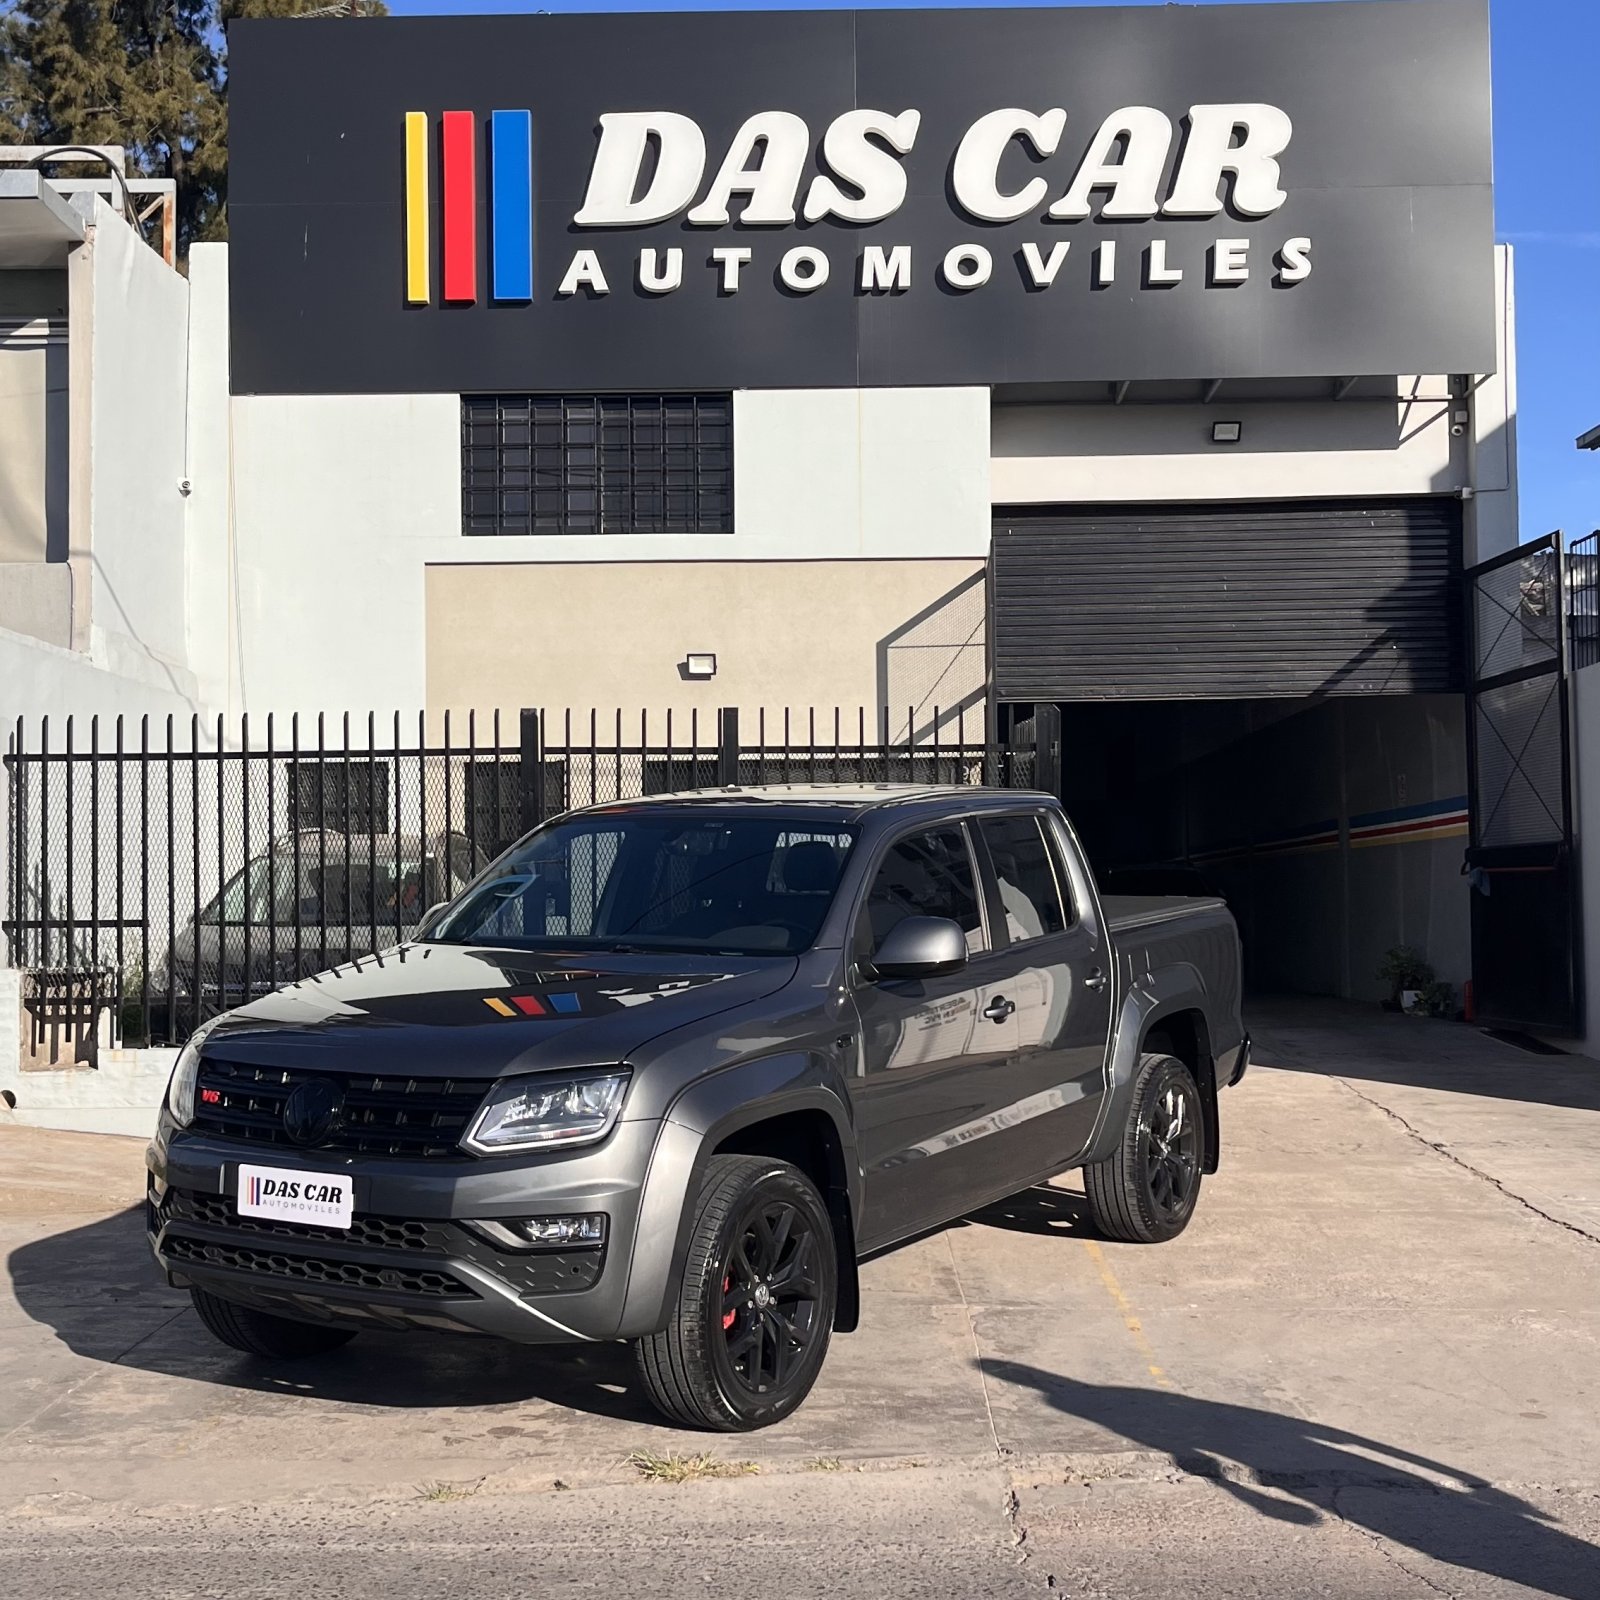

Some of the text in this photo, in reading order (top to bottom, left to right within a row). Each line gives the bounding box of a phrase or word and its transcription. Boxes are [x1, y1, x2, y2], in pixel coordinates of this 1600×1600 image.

[573, 103, 1293, 226] DAS CAR
[557, 236, 1313, 295] AUTOMOVILES
[202, 1088, 221, 1104] V6
[262, 1179, 343, 1204] DAS CAR
[262, 1199, 341, 1215] AUTOMOVILES
